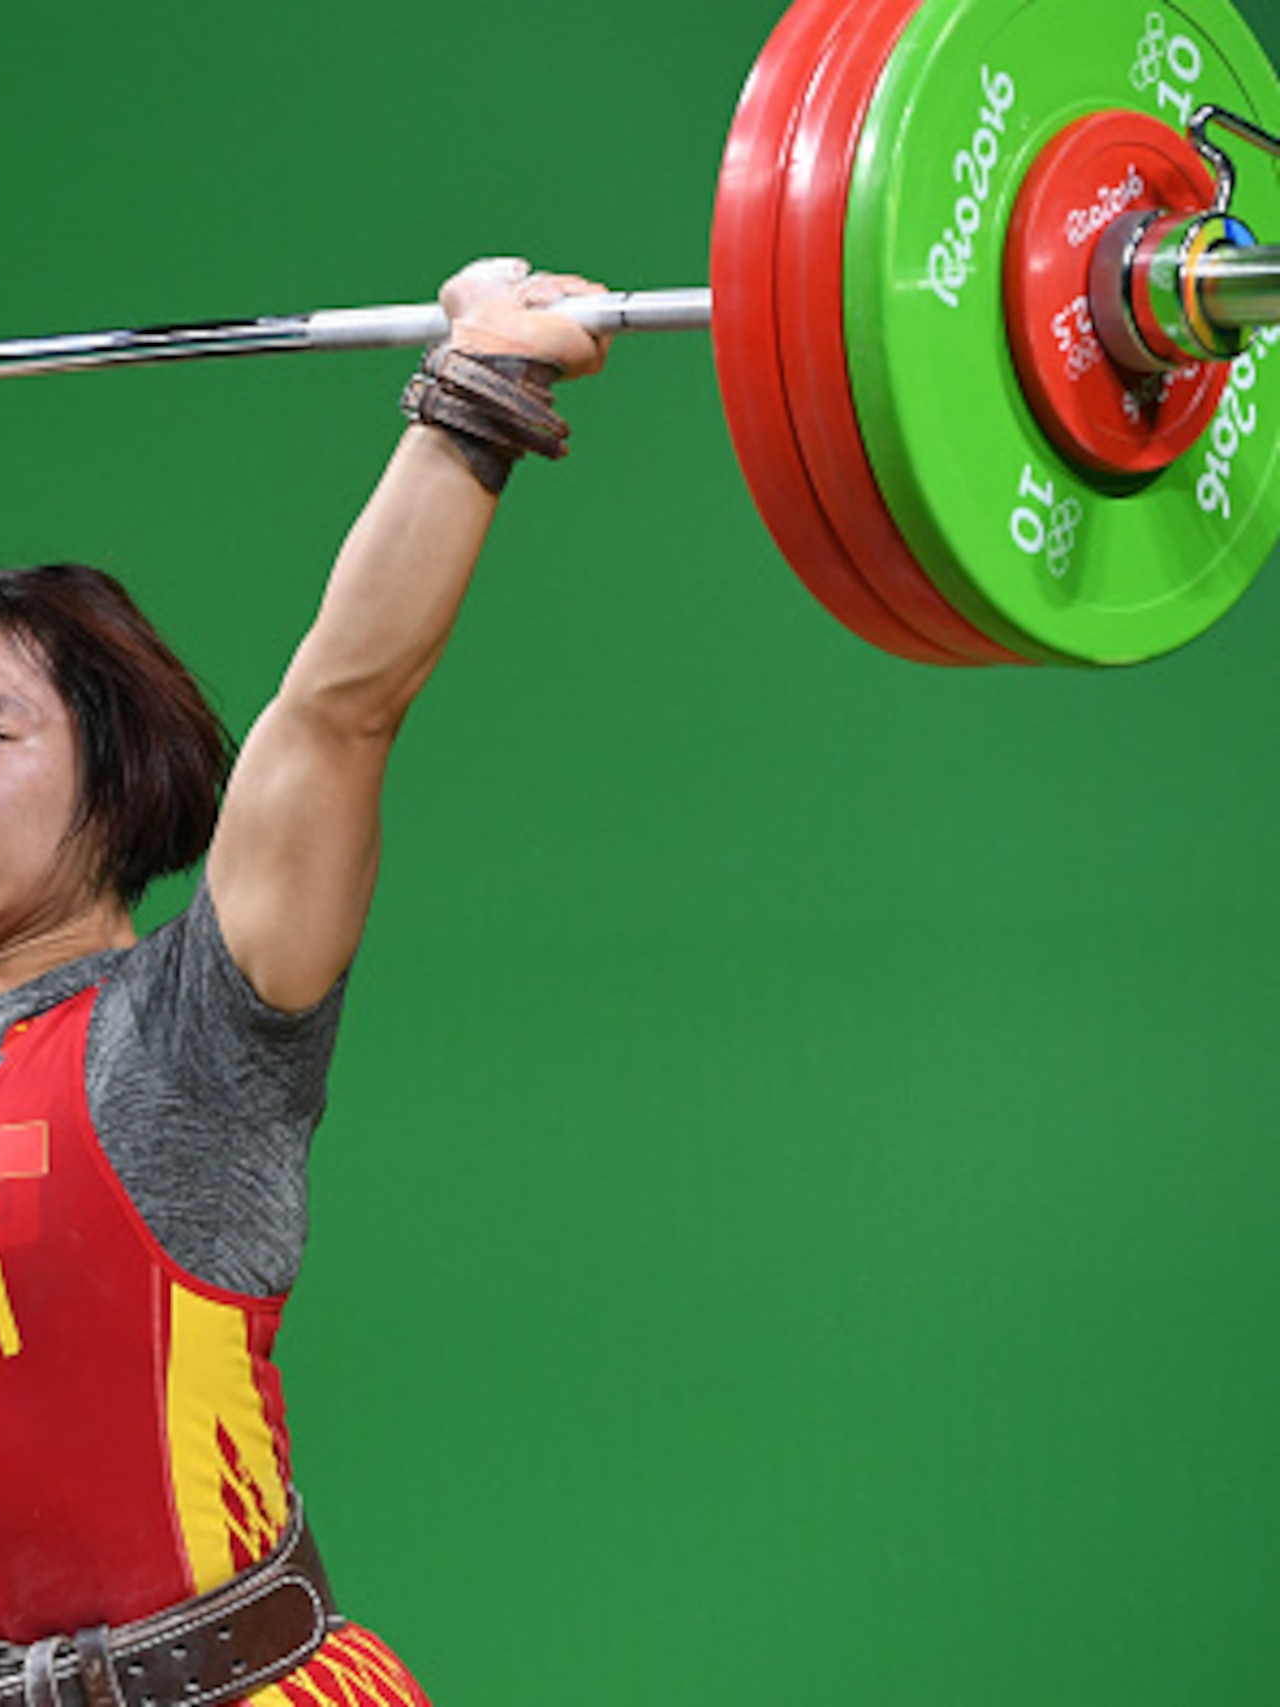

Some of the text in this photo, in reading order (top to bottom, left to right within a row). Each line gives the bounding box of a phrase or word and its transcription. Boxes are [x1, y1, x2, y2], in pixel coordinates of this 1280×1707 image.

[1157, 33, 1203, 127] 10
[927, 64, 1016, 308] Rio2016
[1196, 325, 1280, 519] o2016
[1009, 462, 1054, 555] 10
